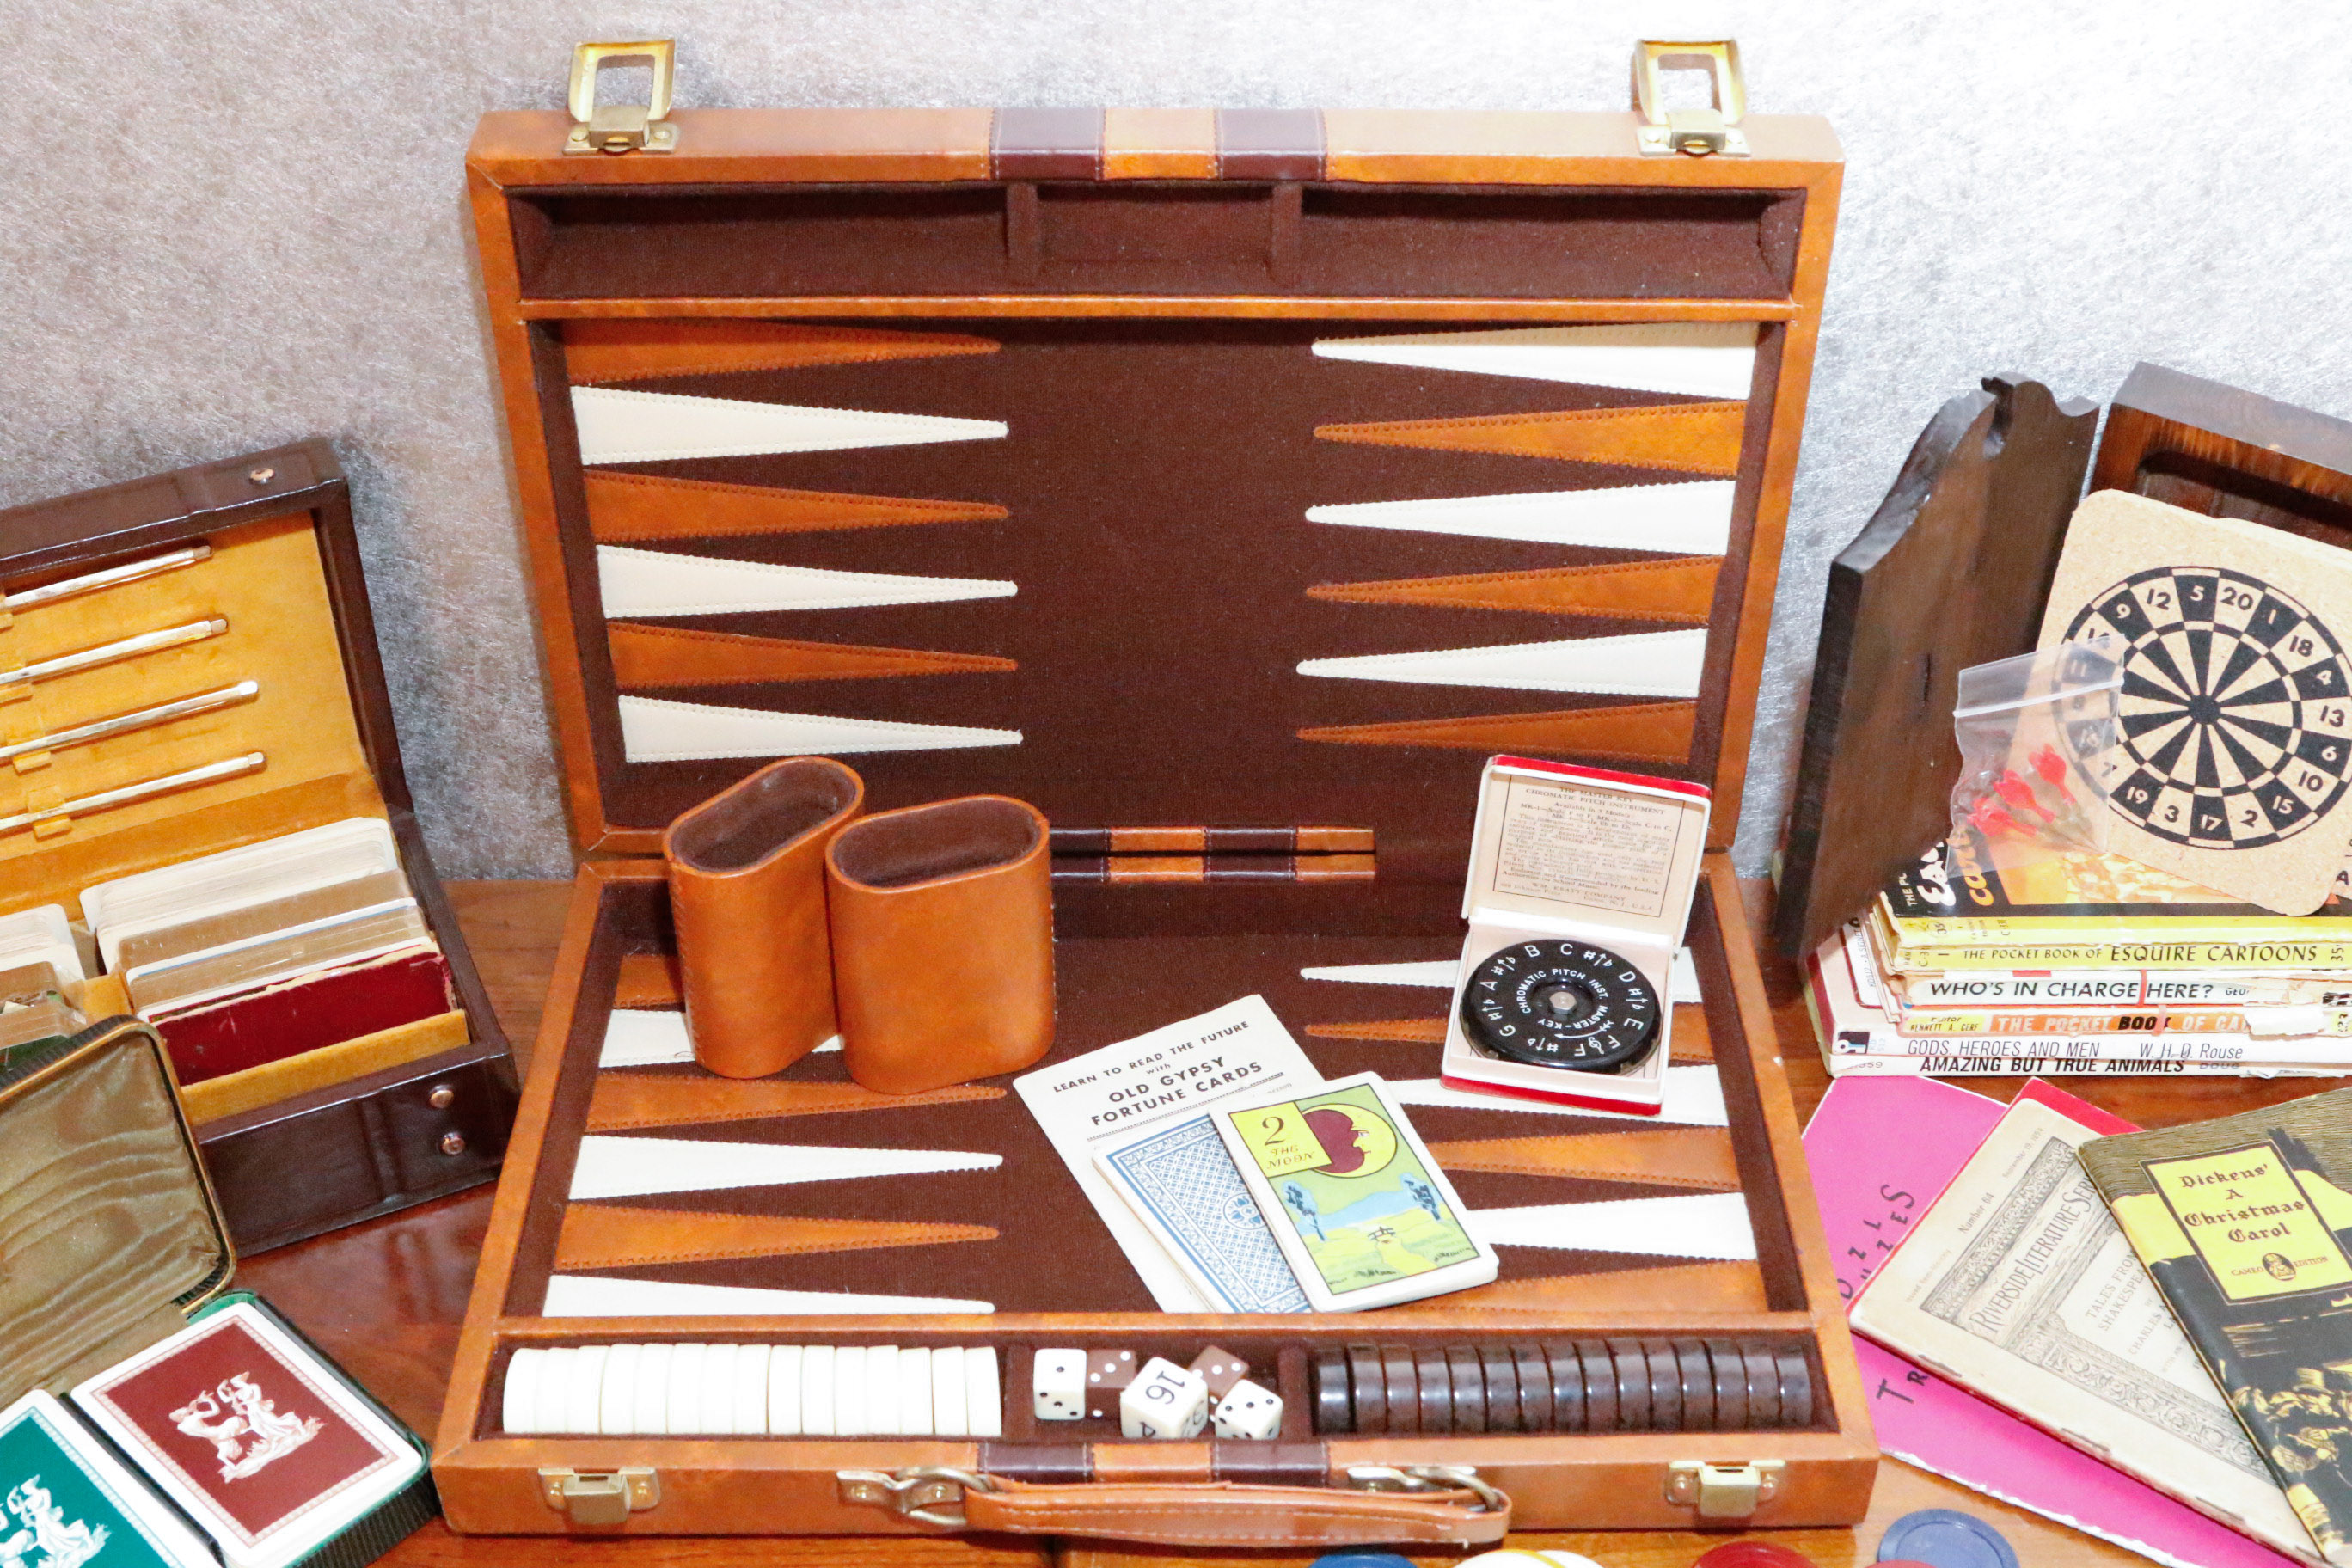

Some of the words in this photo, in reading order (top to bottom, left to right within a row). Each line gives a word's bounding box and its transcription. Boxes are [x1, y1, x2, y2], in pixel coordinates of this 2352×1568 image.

[2147, 588, 2172, 611] 12
[2190, 585, 2205, 601] 5
[2220, 586, 2254, 611] 20
[2116, 603, 2132, 619] 9
[2267, 609, 2277, 625] 1
[2289, 635, 2315, 658] 18
[2316, 669, 2332, 686] 4
[2320, 705, 2346, 728] 13
[2321, 745, 2338, 762] 6
[2298, 770, 2324, 793] 10
[1525, 788, 1575, 802] CHROMATIC
[1580, 796, 1607, 806] PITCH
[1610, 801, 1665, 816] INSTRUMENT
[2126, 786, 2149, 805] 19
[2272, 795, 2294, 815] 15
[2164, 805, 2181, 823] 3
[2201, 814, 2224, 832] 17
[2240, 809, 2259, 828] 2
[1902, 888, 1918, 907] THE
[1524, 945, 1540, 958] B
[1560, 943, 1573, 956] C
[1963, 950, 1986, 959] THE
[1991, 950, 2039, 959] POCKET
[2045, 949, 2079, 959] BOOK
[2086, 948, 2104, 959] OF
[2111, 945, 2196, 962] ESQUIRE
[2208, 945, 2318, 962] CARTOONS
[1552, 968, 1586, 980] PITCH
[1619, 971, 1636, 983] D
[1479, 980, 1498, 990] A
[1516, 970, 1547, 1014] CHROMATIC
[1589, 978, 1609, 1000] INST.
[1931, 981, 2004, 996] WHO'S
[2014, 982, 2039, 996] IN
[2047, 982, 2139, 998] CHARGE
[2147, 983, 2214, 998] HERE?
[1537, 1005, 1609, 1030] MASTER-KEY
[1624, 1017, 1644, 1030] E
[1996, 1017, 2034, 1032] THE
[2043, 1016, 2110, 1032] POCKET
[2182, 1016, 2208, 1032] OF
[1499, 1024, 1516, 1037] G
[1053, 1074, 1098, 1093] LEARN
[1103, 1067, 1122, 1078] TO
[1129, 1053, 1163, 1070] READ
[1169, 1041, 1194, 1056] THE
[1201, 1020, 1249, 1044] FUTURE
[1959, 1040, 2021, 1057] HEROES
[2028, 1041, 2061, 1057] AND
[2066, 1042, 2100, 1057] MEN
[2140, 1043, 2155, 1058] W.
[2199, 1043, 2244, 1059] Rouse
[1146, 1063, 1172, 1075] with
[1920, 1057, 2000, 1073] AMAZING
[2010, 1057, 2046, 1073] BUT
[2054, 1057, 2098, 1073] TRUE
[2105, 1058, 2185, 1073] ANIMALS
[1108, 1083, 1150, 1103] OLD
[1160, 1056, 1225, 1087] GYPSY
[1090, 1089, 1187, 1126] FORTUNE
[1195, 1061, 1263, 1093] CARDS
[1261, 1116, 1286, 1147] 2
[1269, 1144, 1300, 1157] THE
[1265, 1150, 1318, 1171] MOON
[2179, 1164, 2269, 1188] Dickens'
[2226, 1189, 2244, 1200] A
[1957, 1204, 1987, 1234] Number
[2184, 1200, 2305, 1227] Christmas
[2228, 1222, 2291, 1243] Carol
[1969, 1265, 2034, 1333] RIVERSIDE
[2016, 1204, 2081, 1275] LITERATURE
[2231, 1266, 2264, 1277] CAMEO
[2294, 1256, 2329, 1268] EDITION
[2085, 1281, 2116, 1318] TALES
[2128, 1312, 2163, 1356] CHARLES
